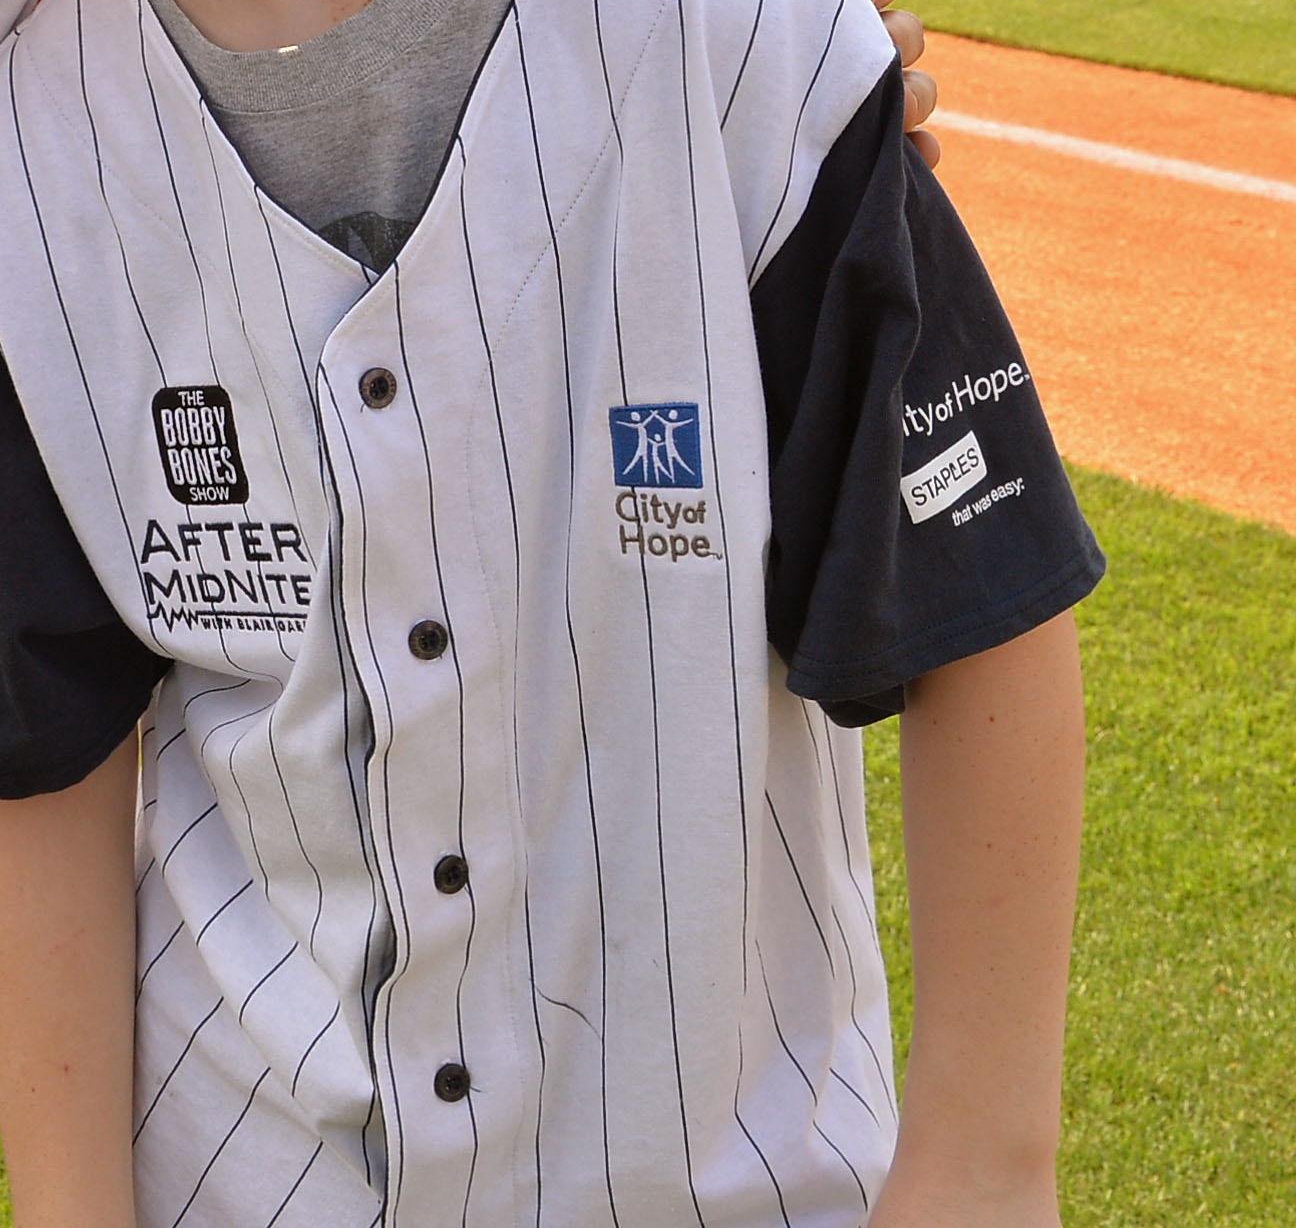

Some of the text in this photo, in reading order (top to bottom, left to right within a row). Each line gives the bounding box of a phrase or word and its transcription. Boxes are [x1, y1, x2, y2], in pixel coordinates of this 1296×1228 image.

[178, 390, 205, 406] THE
[161, 406, 227, 447] BOBBY
[167, 446, 238, 486] BONES
[911, 447, 980, 506] STAPLES
[189, 487, 230, 502] SHOW
[951, 507, 974, 527] that
[974, 494, 993, 515] was
[141, 519, 308, 564] AFTER
[619, 524, 710, 562] Hope
[144, 569, 312, 606] MIDNITE
[200, 617, 233, 631] WITH
[237, 617, 274, 632] BLAIR
